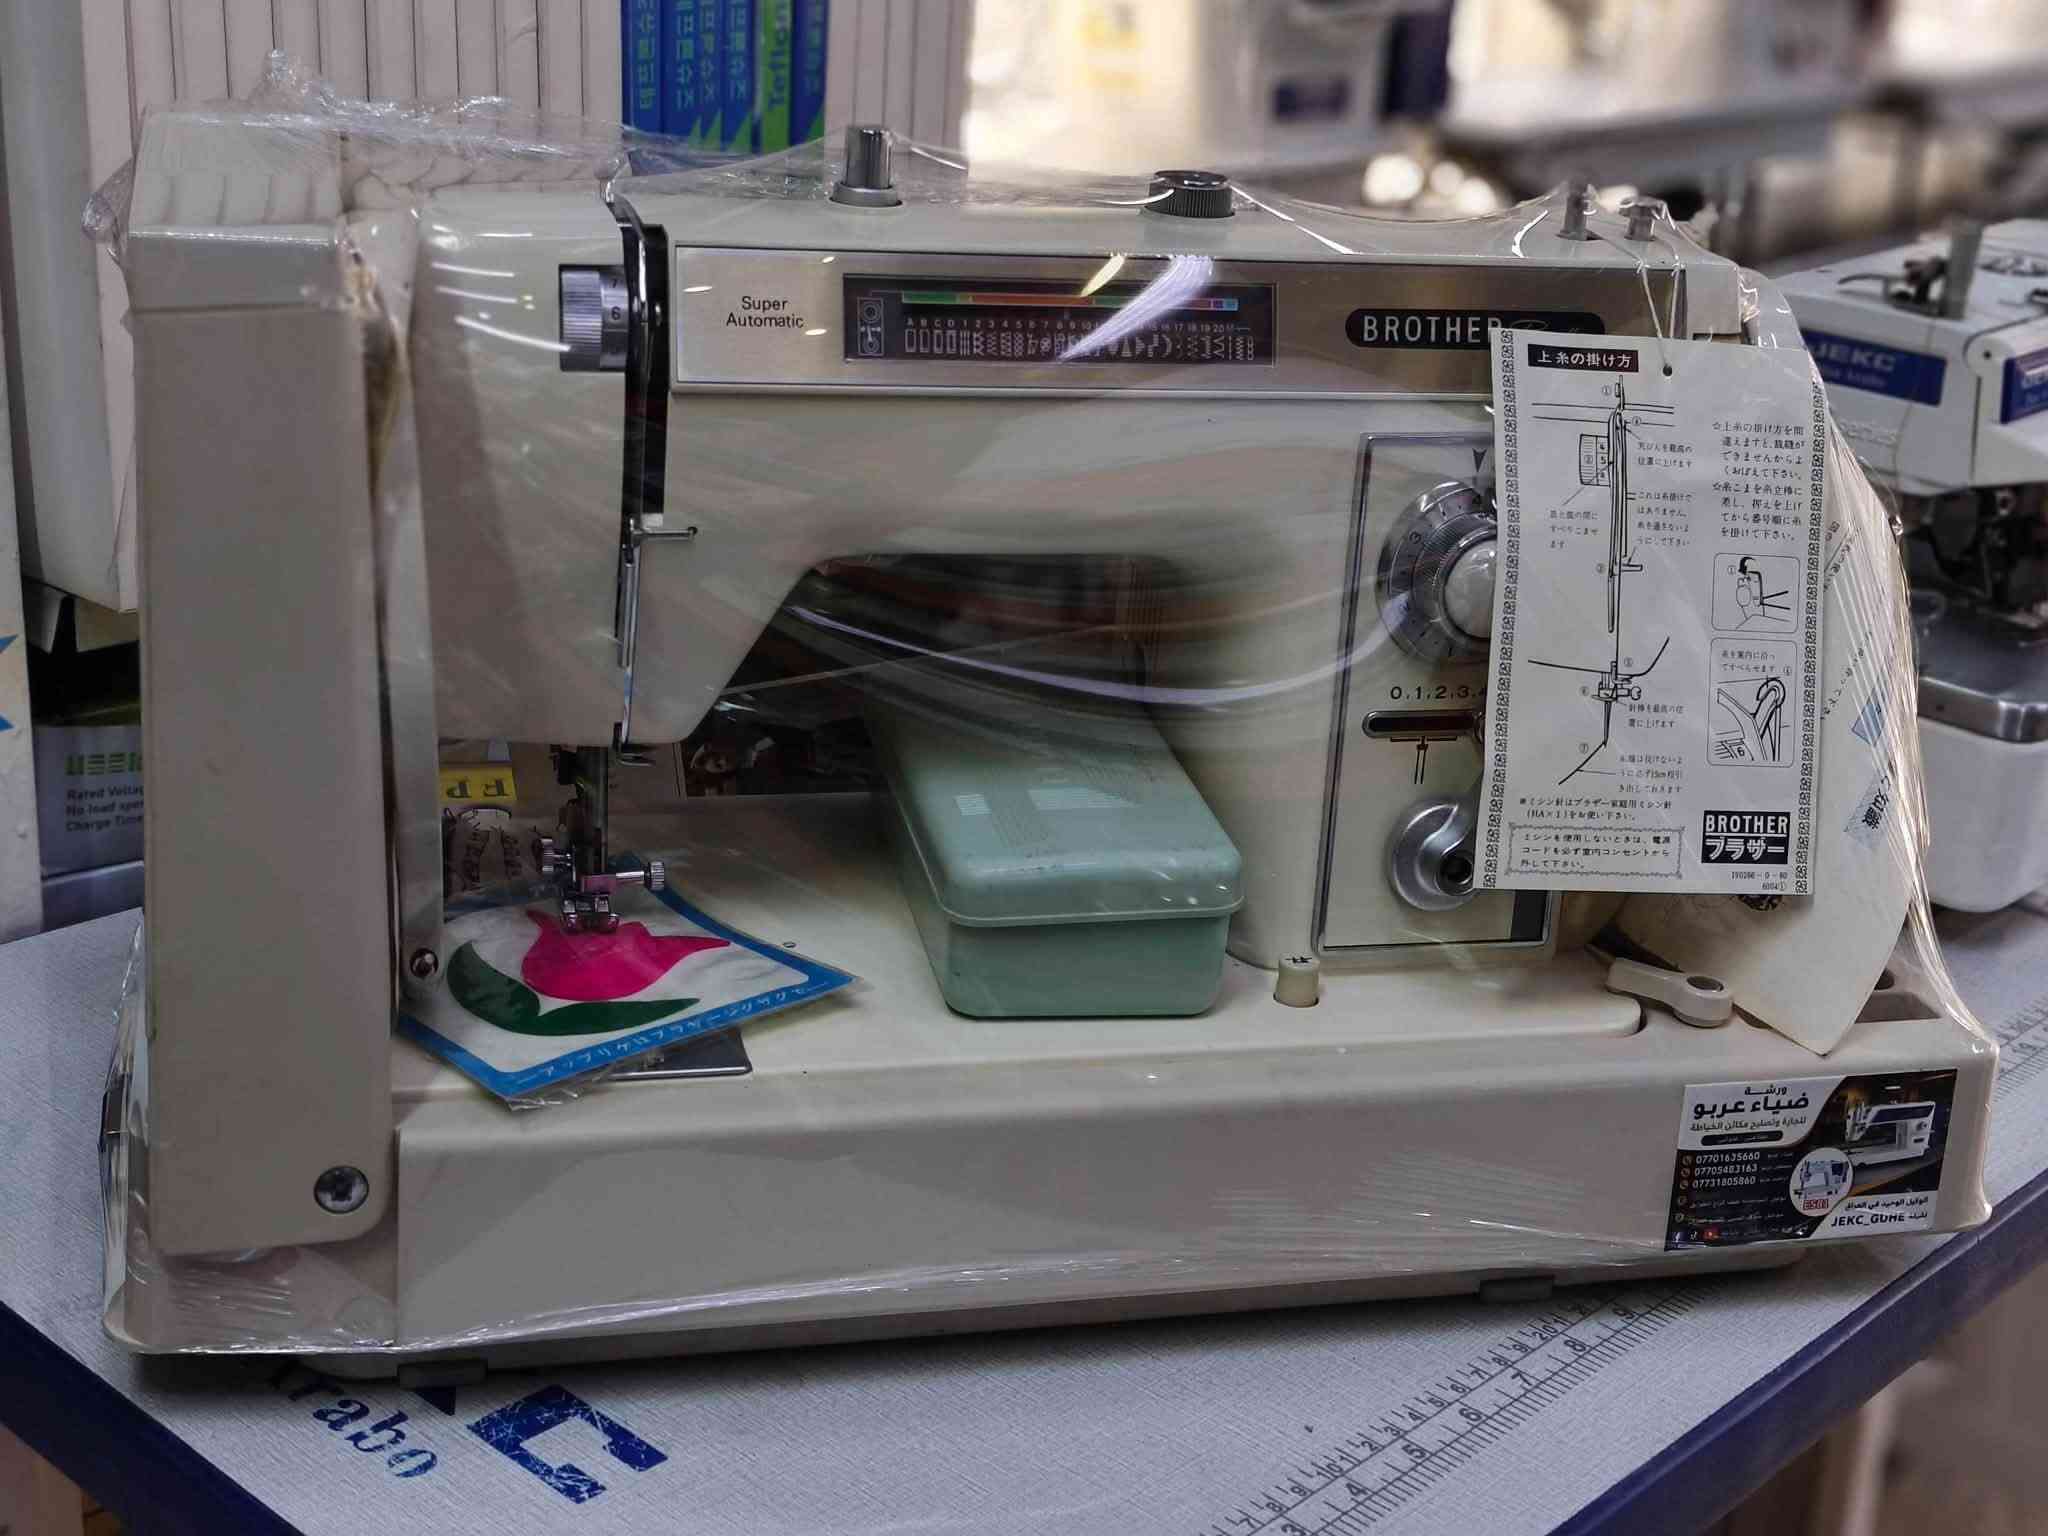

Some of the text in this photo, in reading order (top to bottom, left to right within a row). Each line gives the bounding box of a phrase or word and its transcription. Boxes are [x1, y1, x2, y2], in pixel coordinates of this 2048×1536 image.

[611, 306, 621, 321] 6
[740, 297, 789, 315] Super
[726, 312, 805, 329] Automatic
[1536, 350, 1632, 369] 上糸の掛け方
[1705, 814, 1789, 834] BROTHER
[1705, 836, 1786, 861] ブラザー
[1693, 1092, 1809, 1120] ضياء عربو
[1346, 1483, 1368, 1497] 4
[1402, 1444, 1426, 1460] 5
[1458, 1406, 1482, 1423] 6
[1511, 1371, 1533, 1386] 7
[1563, 1338, 1588, 1353] 8
[1610, 1306, 1636, 1320] 9
